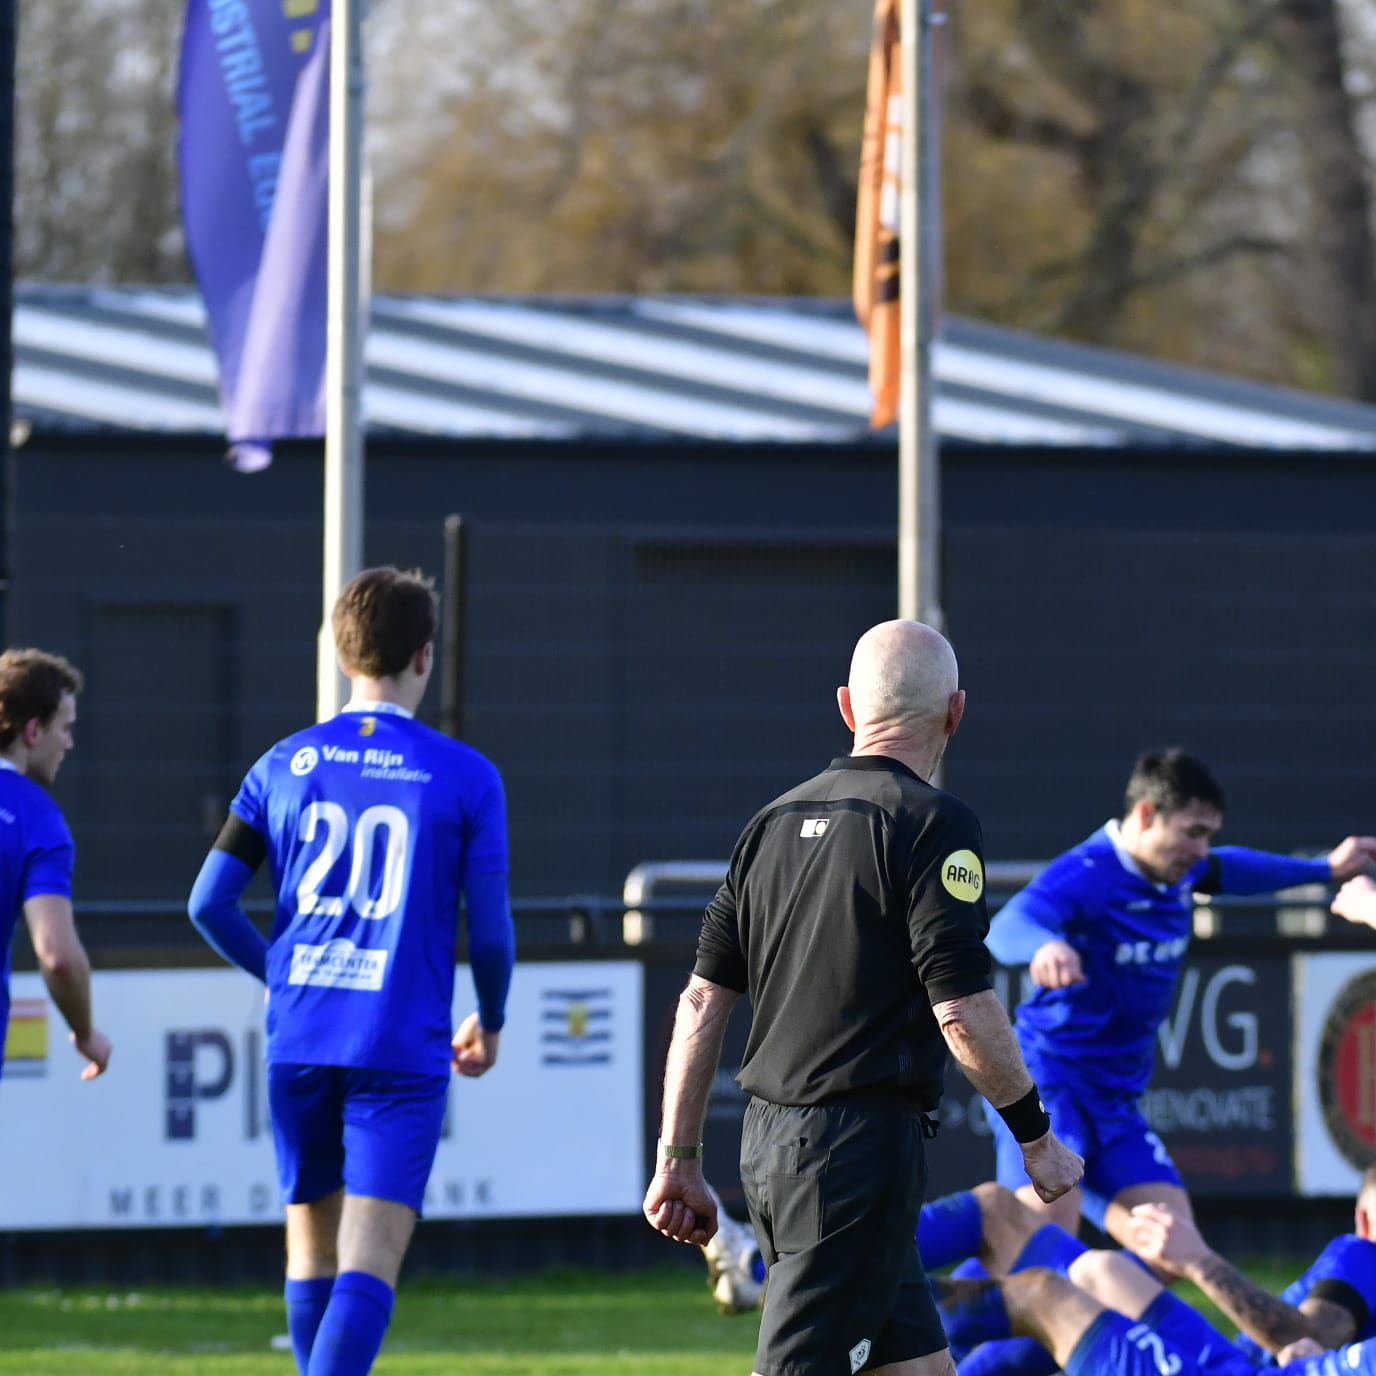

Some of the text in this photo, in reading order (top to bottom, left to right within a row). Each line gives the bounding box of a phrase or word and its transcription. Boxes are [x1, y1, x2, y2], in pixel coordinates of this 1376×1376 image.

[322, 745, 404, 767] Van Rijn
[360, 765, 433, 784] installatie
[296, 800, 410, 921] 20
[945, 863, 981, 890] ARAG
